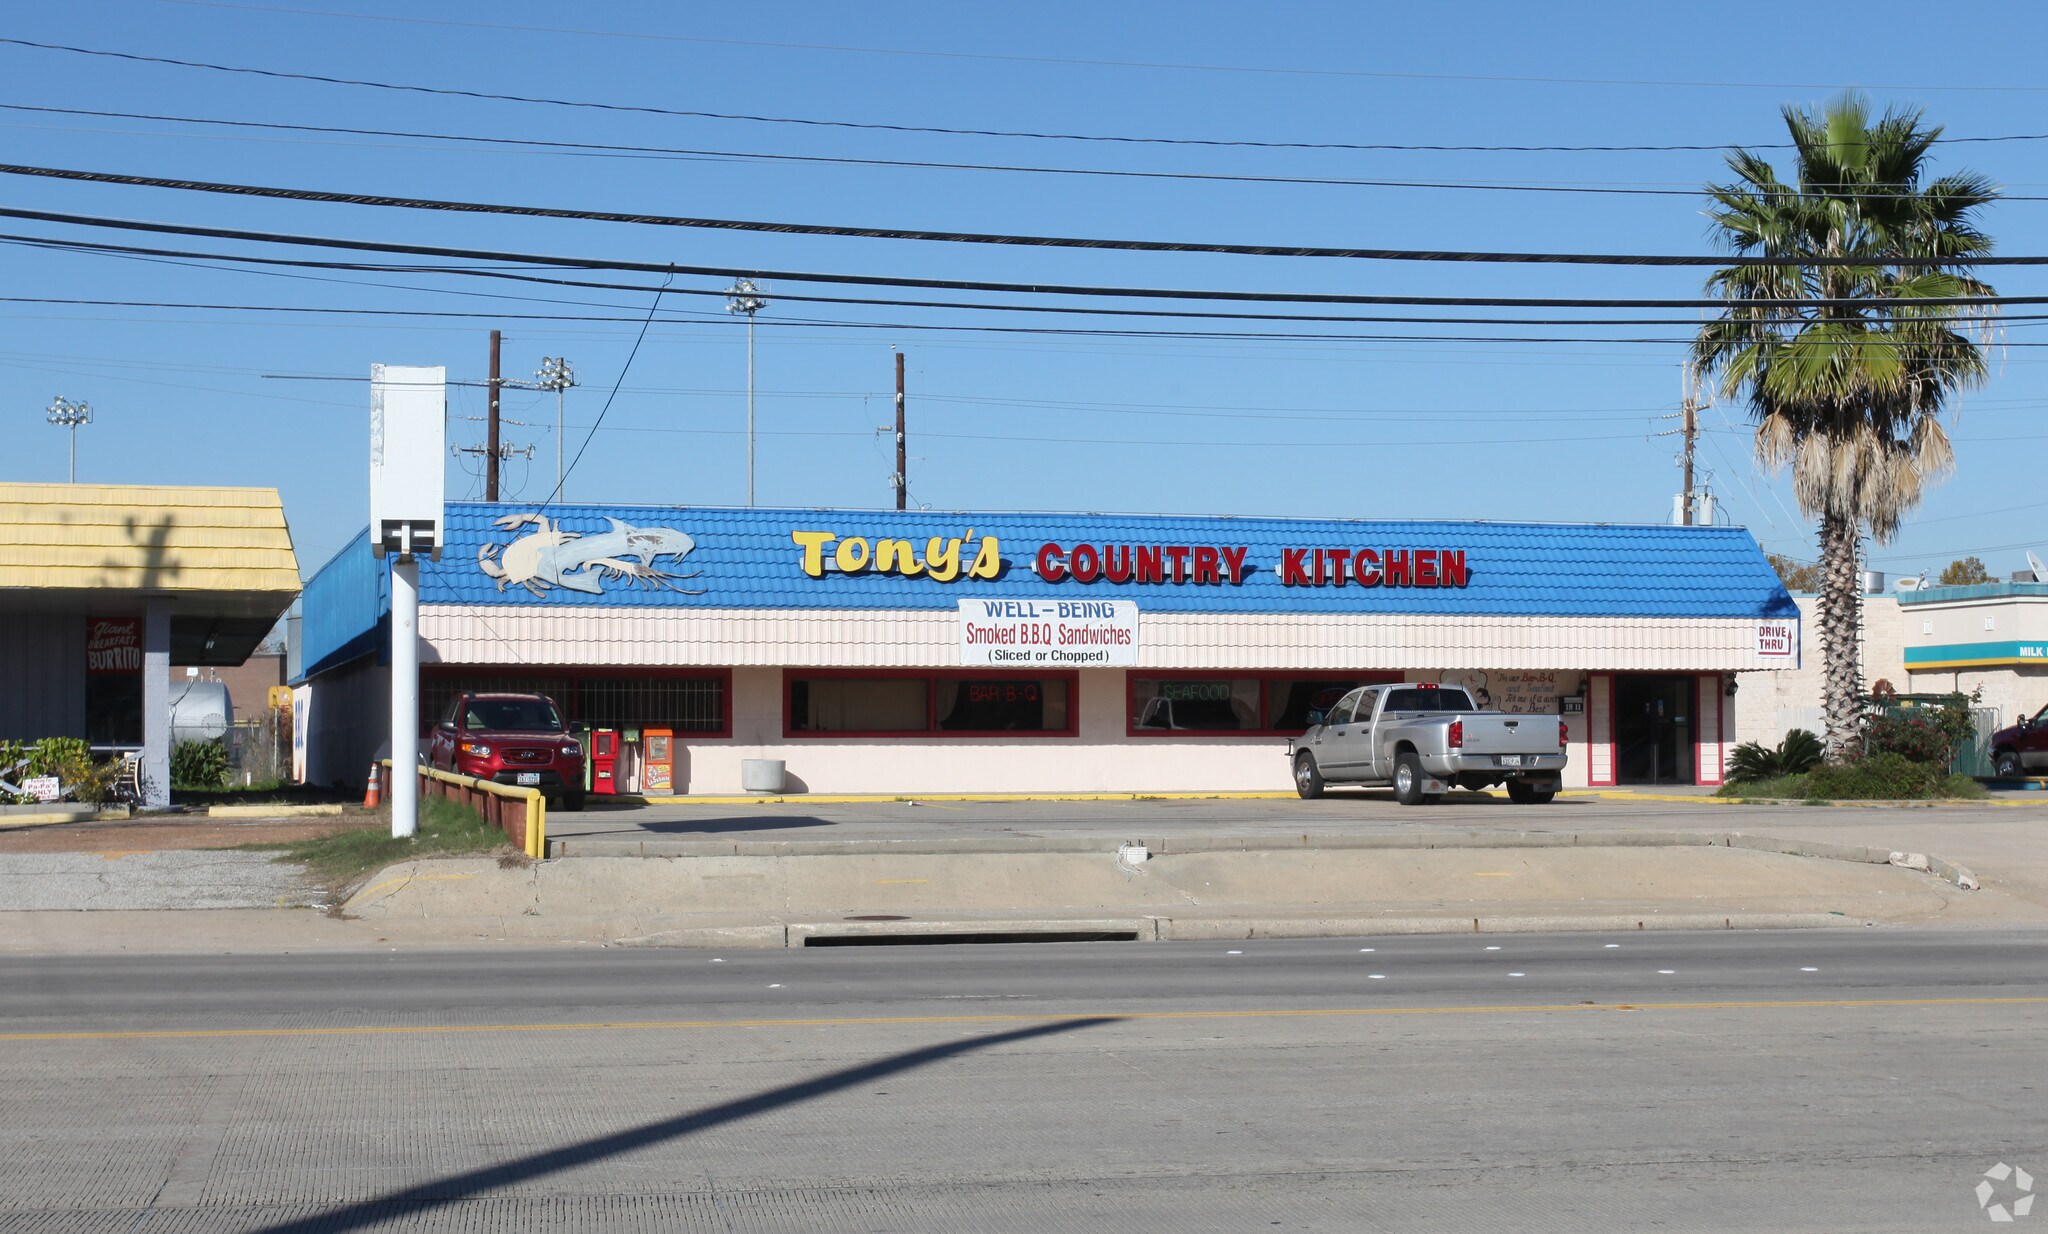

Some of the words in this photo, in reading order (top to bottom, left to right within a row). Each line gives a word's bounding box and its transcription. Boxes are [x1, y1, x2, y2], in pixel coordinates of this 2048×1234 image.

[791, 528, 1000, 582] Tony's
[1036, 542, 1249, 584] COUNTRY
[1281, 548, 1467, 586] KITCHEN
[966, 622, 1016, 645] Smoked
[1020, 623, 1052, 646] B.B.Q
[1058, 623, 1131, 645] Sandwiches
[1759, 626, 1786, 637] DRIVE
[87, 635, 137, 649] BREAKFAST
[1759, 639, 1783, 649] THRU
[87, 646, 140, 670] BURRITO
[988, 650, 1031, 662] (Sliced
[1035, 652, 1048, 661] or
[1051, 650, 1110, 663] Chopped)
[2019, 646, 2044, 657] MILK
[969, 685, 1037, 702] BAR-B-Q
[1164, 684, 1230, 700] SEAFOOD
[1511, 704, 1522, 713] the
